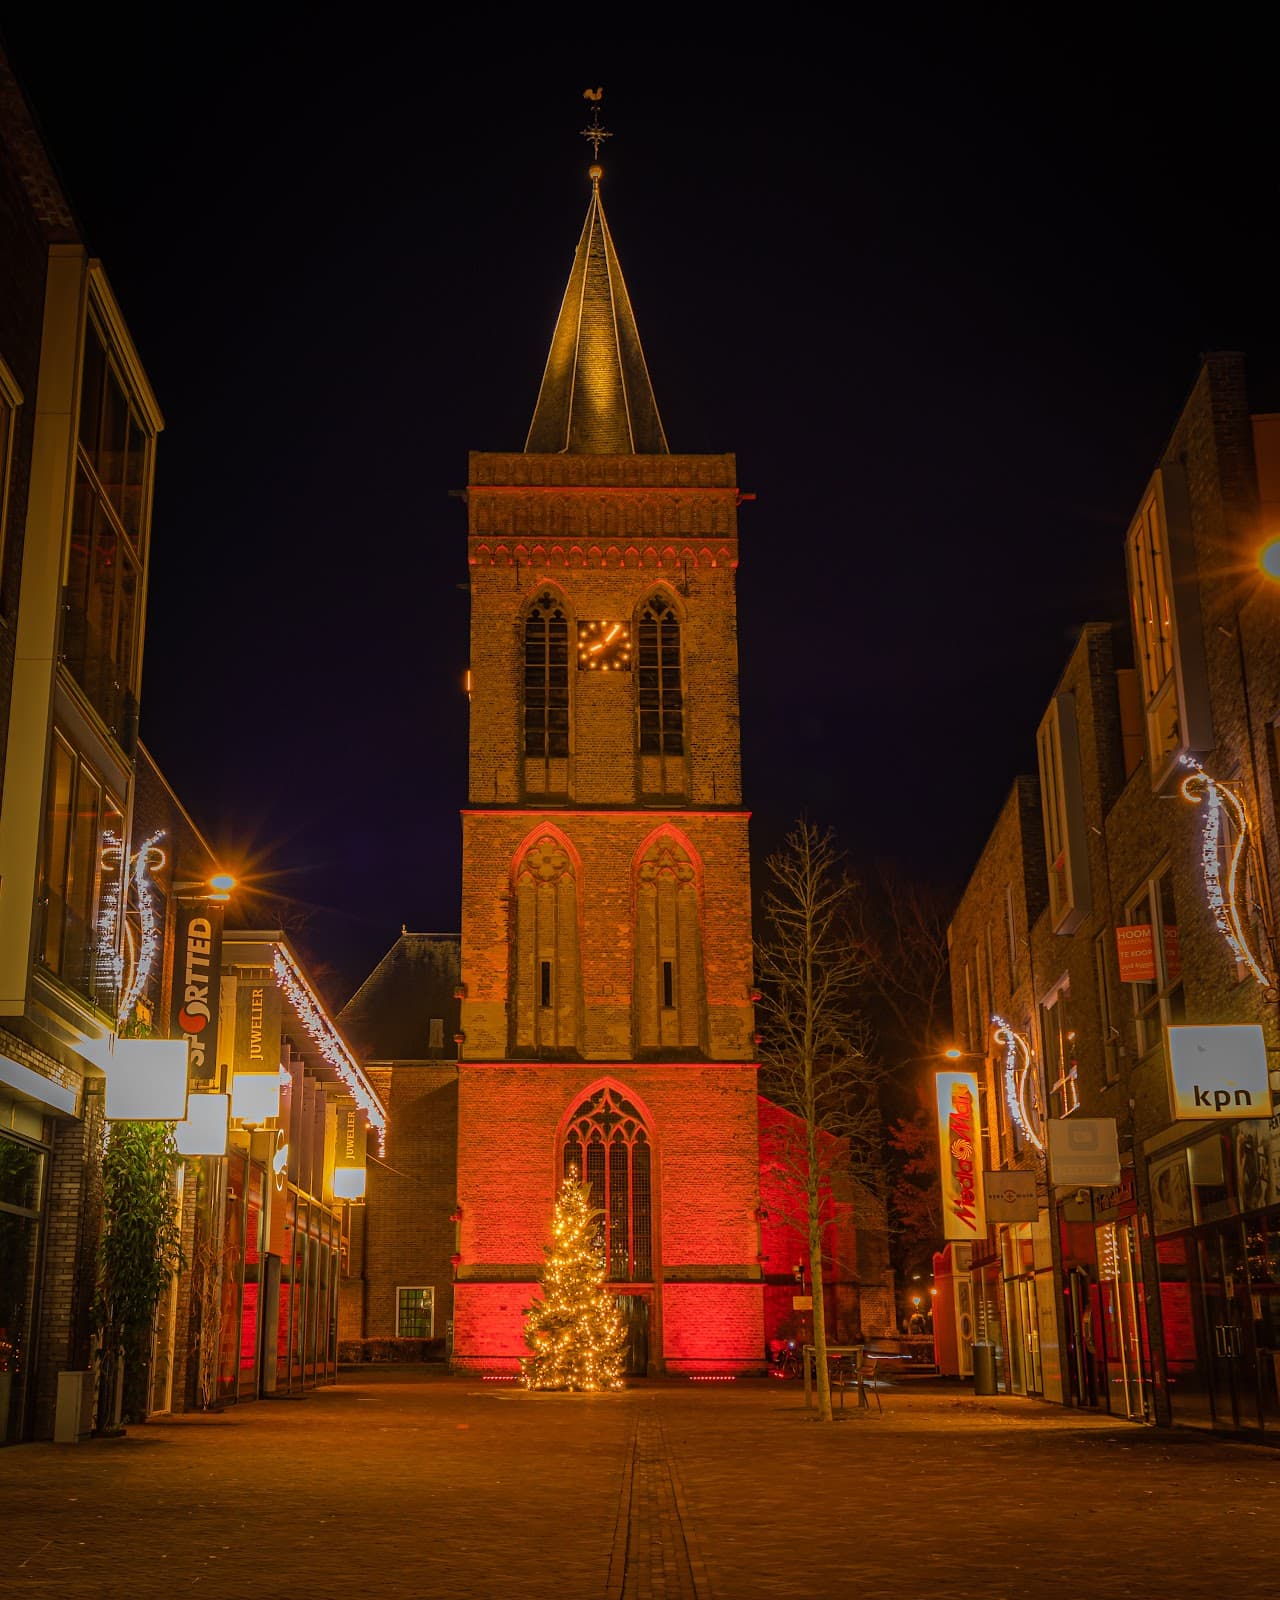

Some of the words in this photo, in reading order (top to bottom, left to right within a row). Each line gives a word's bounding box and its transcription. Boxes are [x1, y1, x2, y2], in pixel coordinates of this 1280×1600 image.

[1117, 928, 1152, 940] HOOM
[250, 987, 264, 1062] JUWELIER
[1193, 1085, 1252, 1112] kpn
[345, 1111, 356, 1160] JUWELIER
